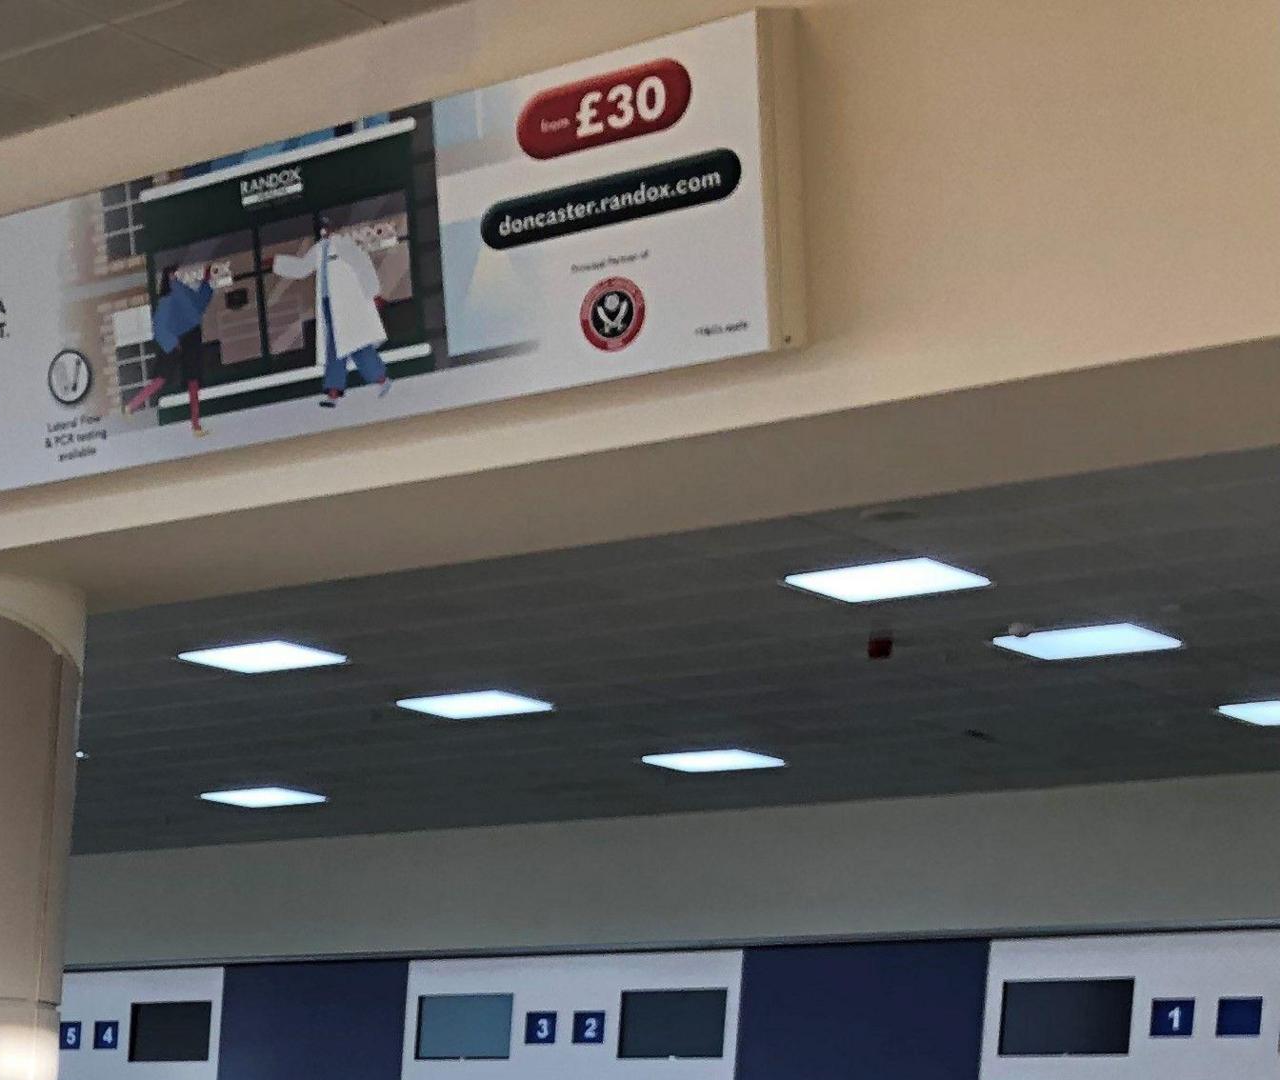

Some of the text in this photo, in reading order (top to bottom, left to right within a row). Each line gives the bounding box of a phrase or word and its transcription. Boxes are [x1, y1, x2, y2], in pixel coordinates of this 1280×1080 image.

[576, 75, 666, 138] £30
[498, 171, 721, 237] doncaster.randox.com
[536, 1018, 597, 1039] 3 2
[1168, 1006, 1181, 1031] 1
[66, 1026, 113, 1045] 5 4
